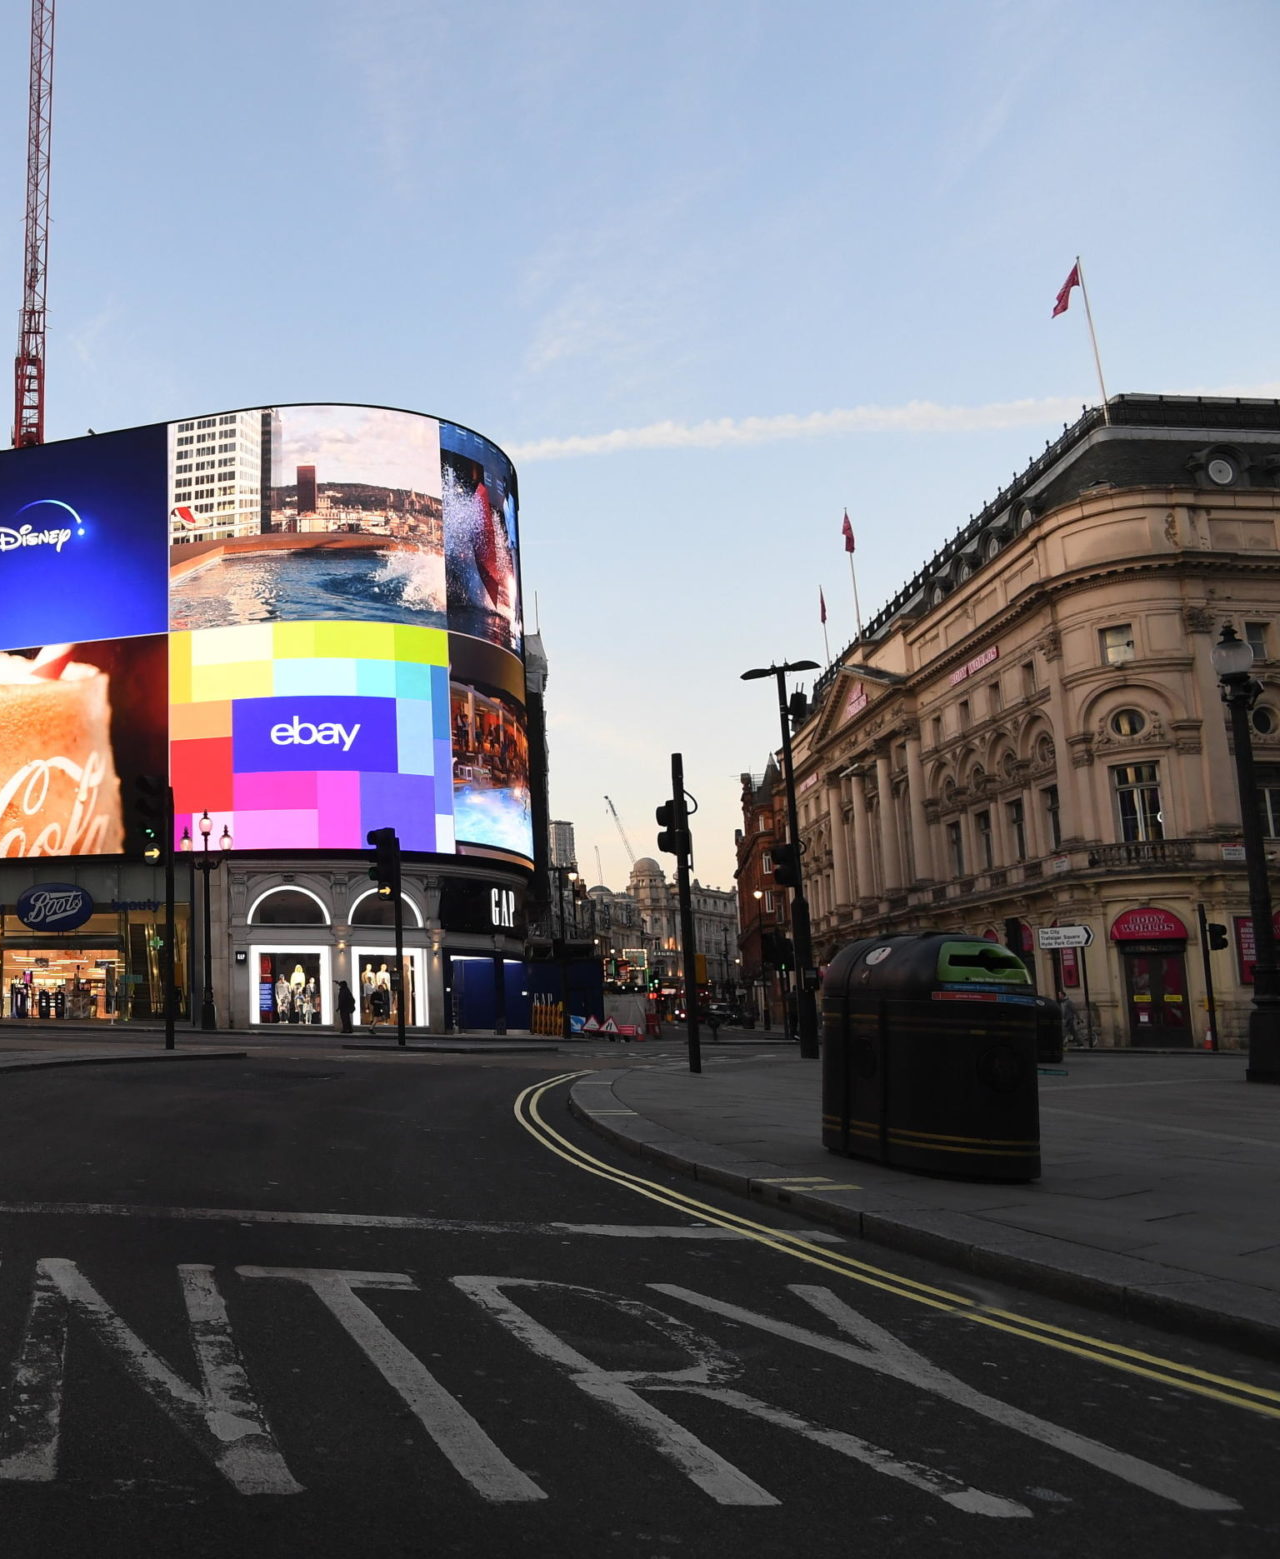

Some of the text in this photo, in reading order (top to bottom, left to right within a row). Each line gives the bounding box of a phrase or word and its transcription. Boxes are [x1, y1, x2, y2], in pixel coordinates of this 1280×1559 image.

[270, 715, 361, 752] ebay
[23, 890, 83, 924] Boots
[111, 899, 160, 911] beauty
[490, 887, 516, 927] GAP
[1121, 923, 1175, 932] WORLDS
[1129, 914, 1165, 924] BODY
